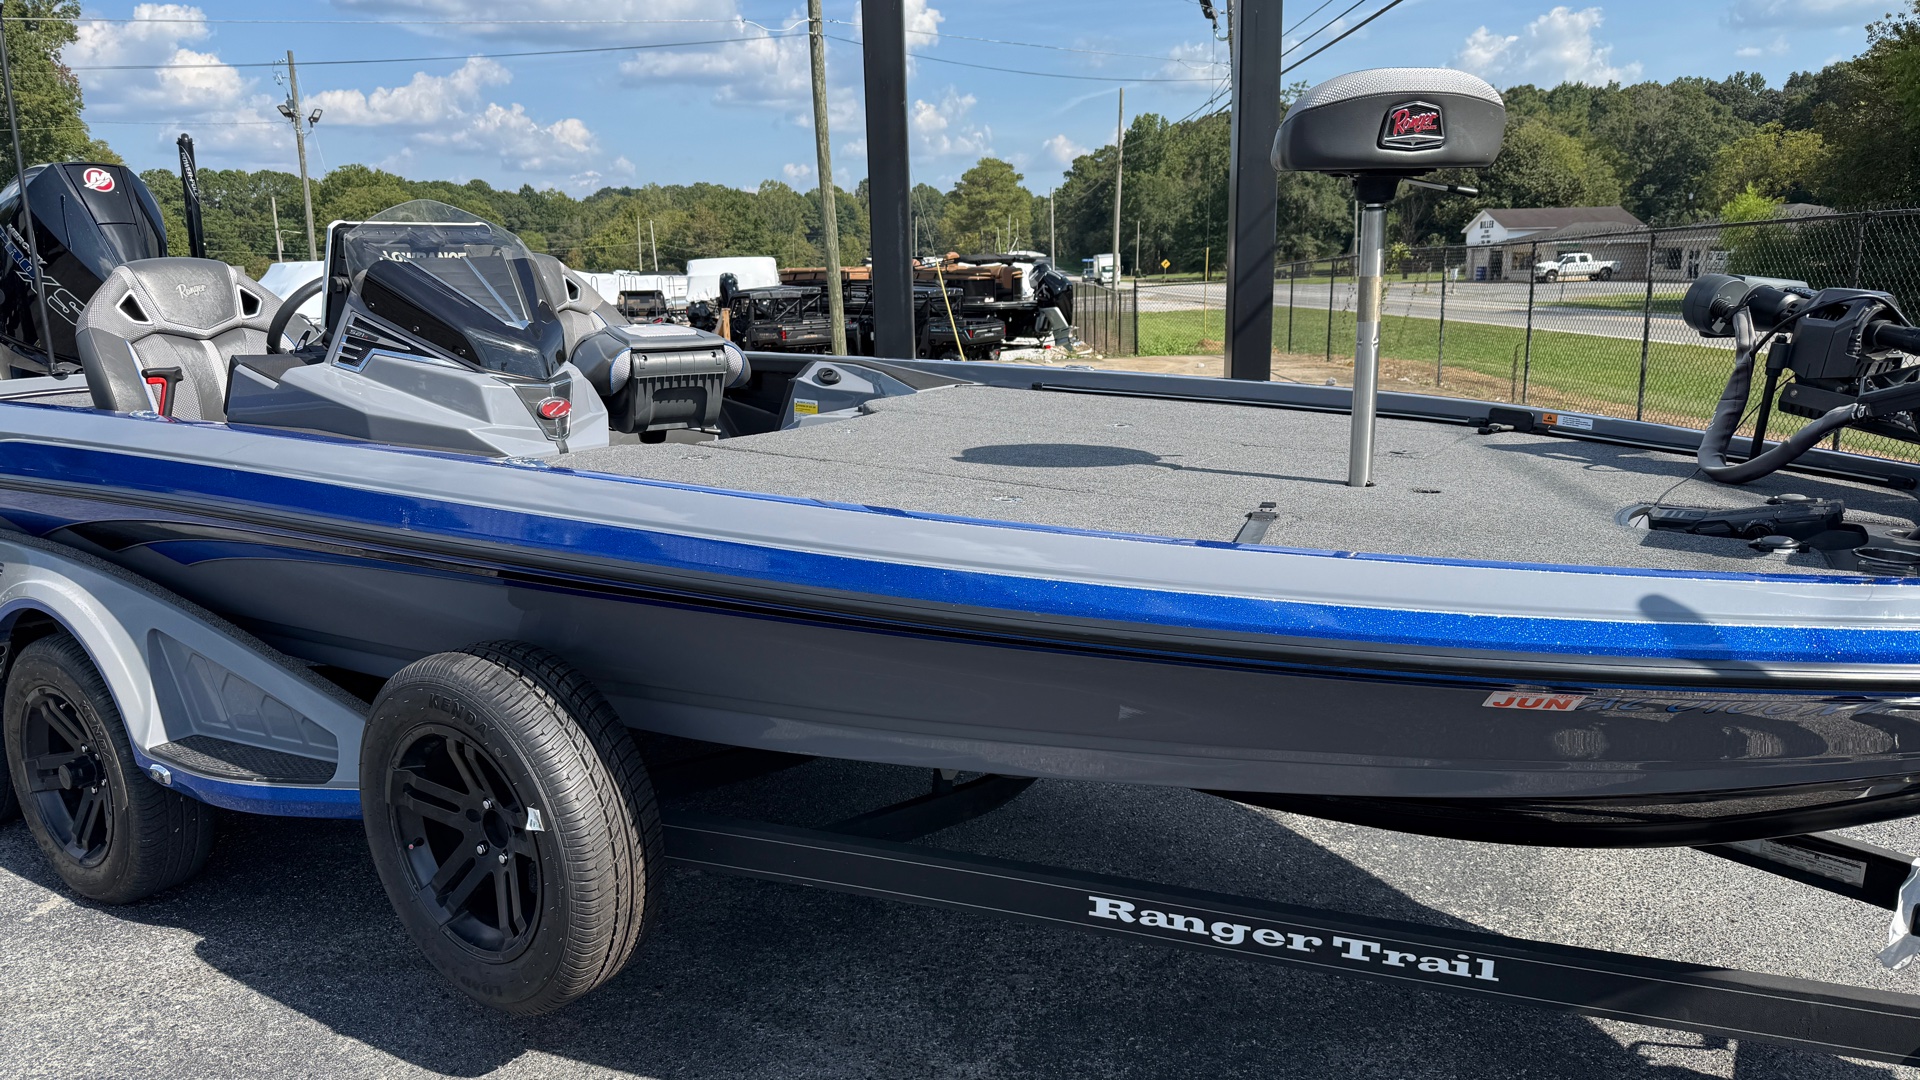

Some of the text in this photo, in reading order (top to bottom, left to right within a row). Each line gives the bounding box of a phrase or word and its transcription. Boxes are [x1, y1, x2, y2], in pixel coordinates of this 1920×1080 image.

[1391, 108, 1439, 136] Ranger
[175, 283, 207, 299] Ranger
[428, 692, 488, 738] KENDA
[1492, 697, 1574, 710] JUN
[82, 699, 113, 763] KENDA
[1088, 895, 1500, 982] Ranger Trail
